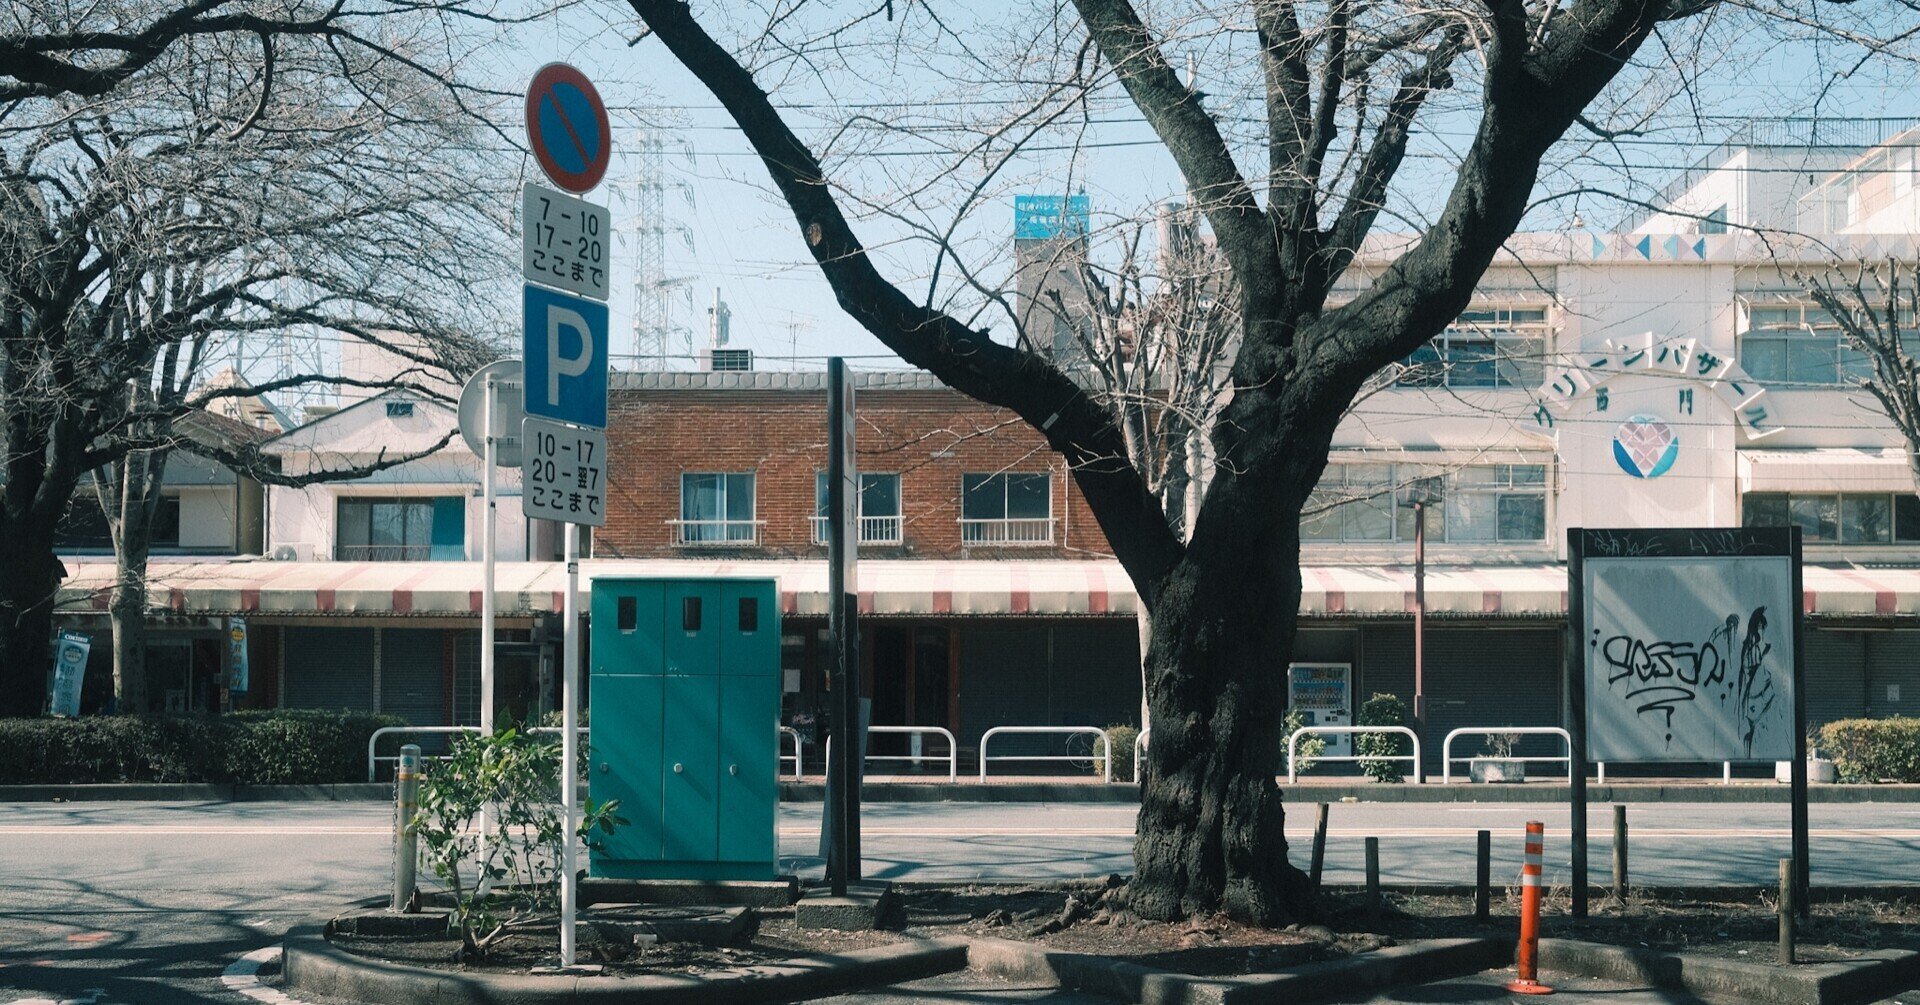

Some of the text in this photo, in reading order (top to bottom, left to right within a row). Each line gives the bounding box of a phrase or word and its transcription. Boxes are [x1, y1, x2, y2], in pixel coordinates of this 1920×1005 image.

[532, 249, 603, 288] ここまで
[547, 304, 594, 407] P
[532, 486, 600, 515] ここまで
